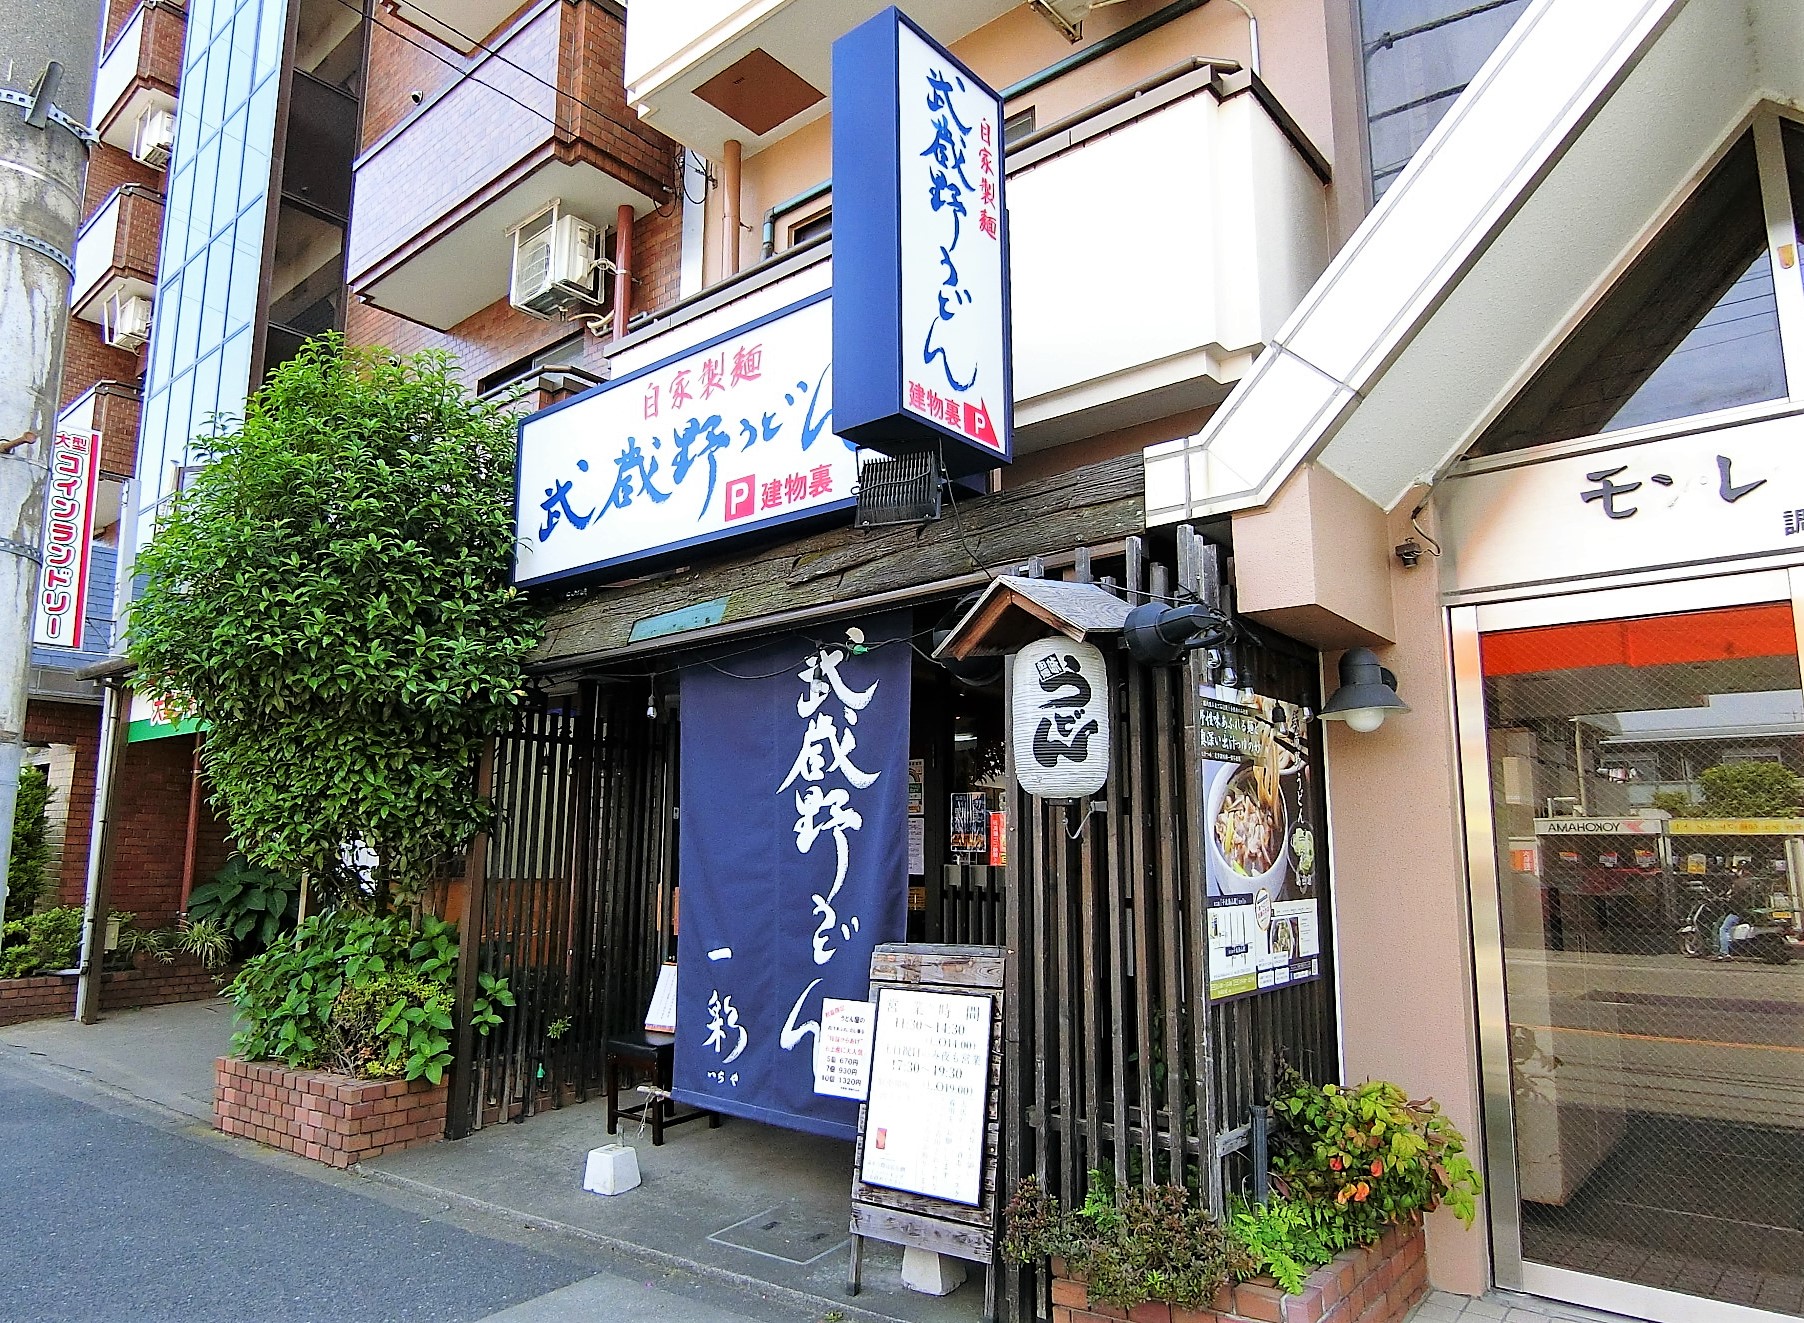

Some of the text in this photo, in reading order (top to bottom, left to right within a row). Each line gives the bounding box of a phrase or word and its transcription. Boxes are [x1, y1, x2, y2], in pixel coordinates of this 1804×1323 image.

[920, 68, 977, 391] 武蔵野うどん
[979, 118, 996, 240] 自家製麺
[643, 343, 763, 421] 自家製麺
[908, 380, 962, 430] 建物裏
[55, 431, 89, 454] 大型
[538, 362, 862, 543] 武蔵野うどん
[760, 464, 833, 511] 建物裏
[43, 454, 83, 638] コインランドリー
[1033, 654, 1098, 768] うどん
